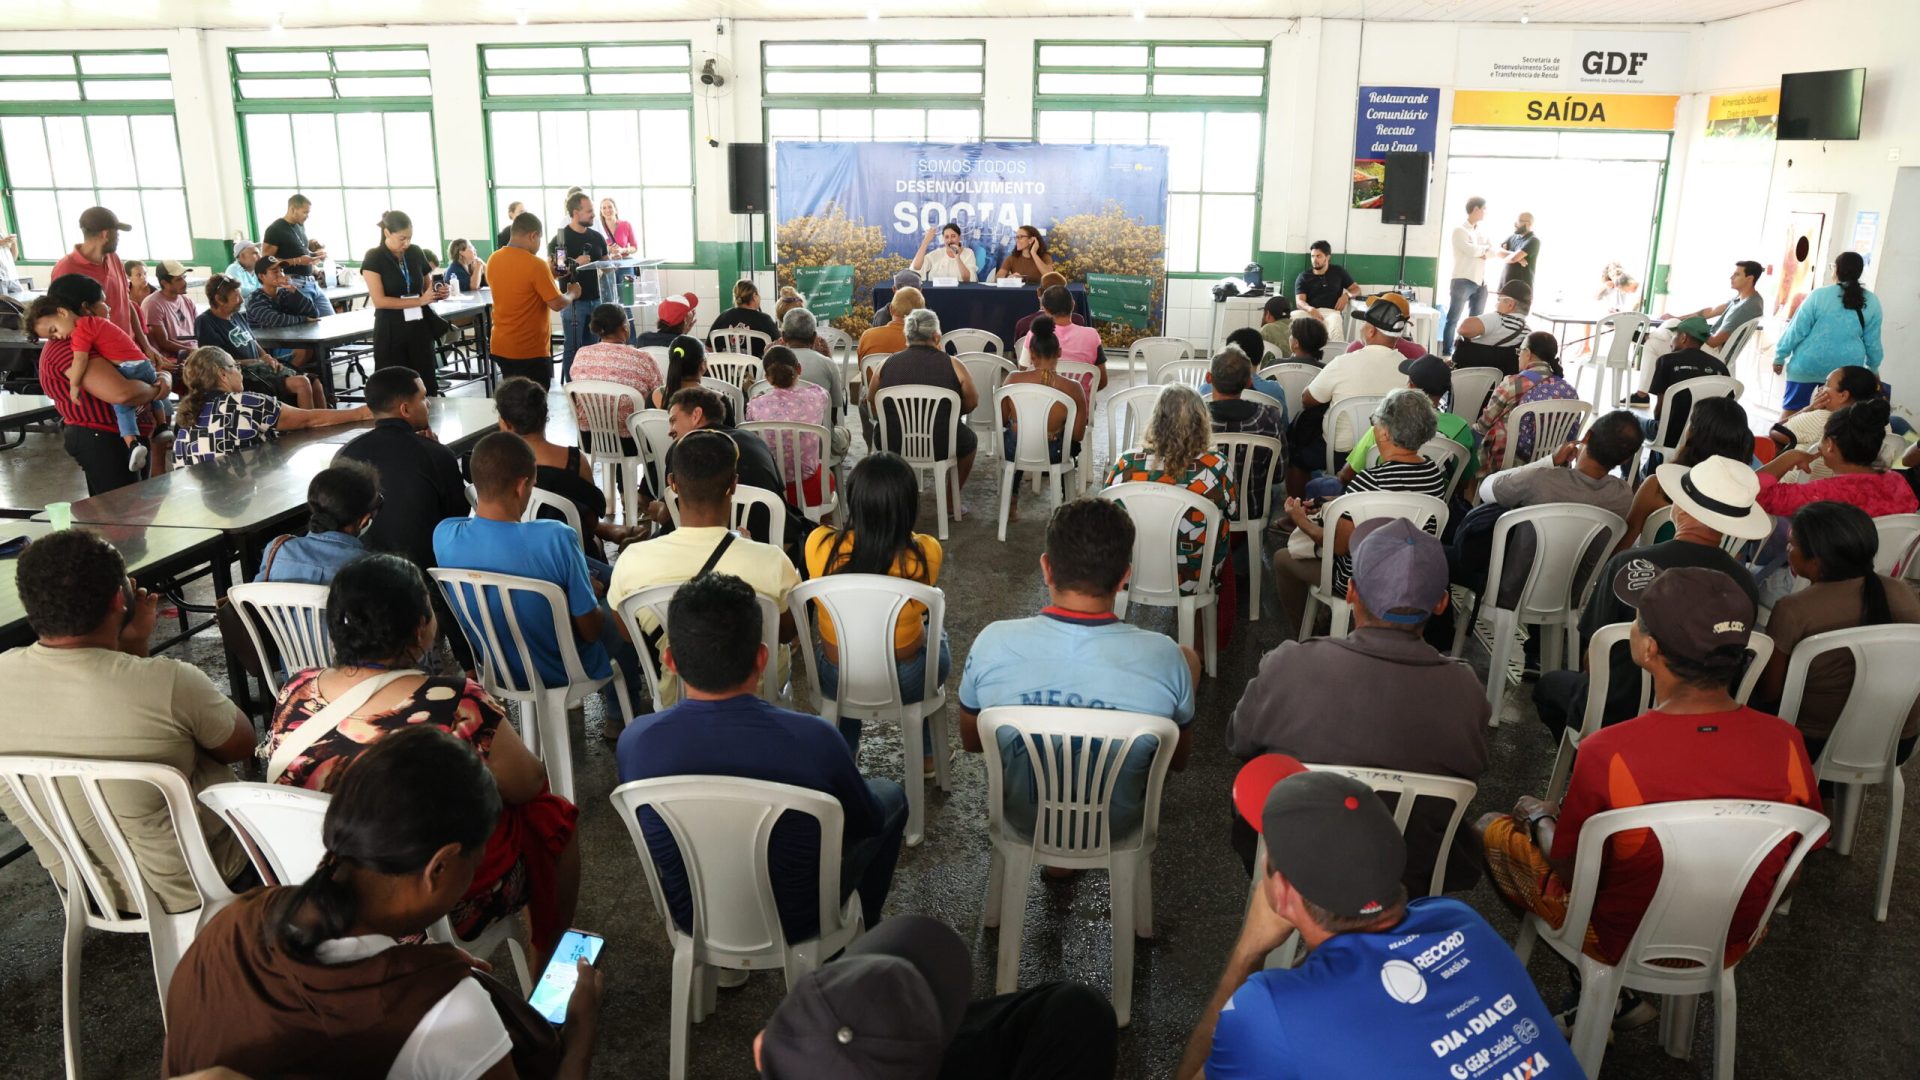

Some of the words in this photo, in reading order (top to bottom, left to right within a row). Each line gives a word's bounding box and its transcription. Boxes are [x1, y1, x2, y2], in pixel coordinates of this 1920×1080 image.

[1493, 63, 1542, 71] Desenvolvimento
[1582, 51, 1648, 76] GDF
[1368, 91, 1429, 104] Restaurante
[1526, 96, 1606, 122] SAÍDA
[1366, 108, 1429, 120] Comunitário
[1375, 124, 1416, 136] Recanto
[1371, 141, 1390, 152] das
[1391, 140, 1418, 152] Emas
[918, 159, 972, 173] SOMOS
[975, 159, 1026, 174] TODOS
[896, 180, 1045, 194] DESENVOLVIMENTO
[893, 201, 1047, 236] SOCIAL
[1412, 930, 1465, 970] RECORD
[1440, 957, 1471, 980] BRASÍLIA
[1464, 1027, 1473, 1037] A
[1468, 1008, 1502, 1035] DIA
[1430, 1030, 1468, 1058] DIA
[1464, 1048, 1491, 1072] GEAP
[1490, 1035, 1518, 1057] saúde
[1495, 1051, 1550, 1080] AIXA
